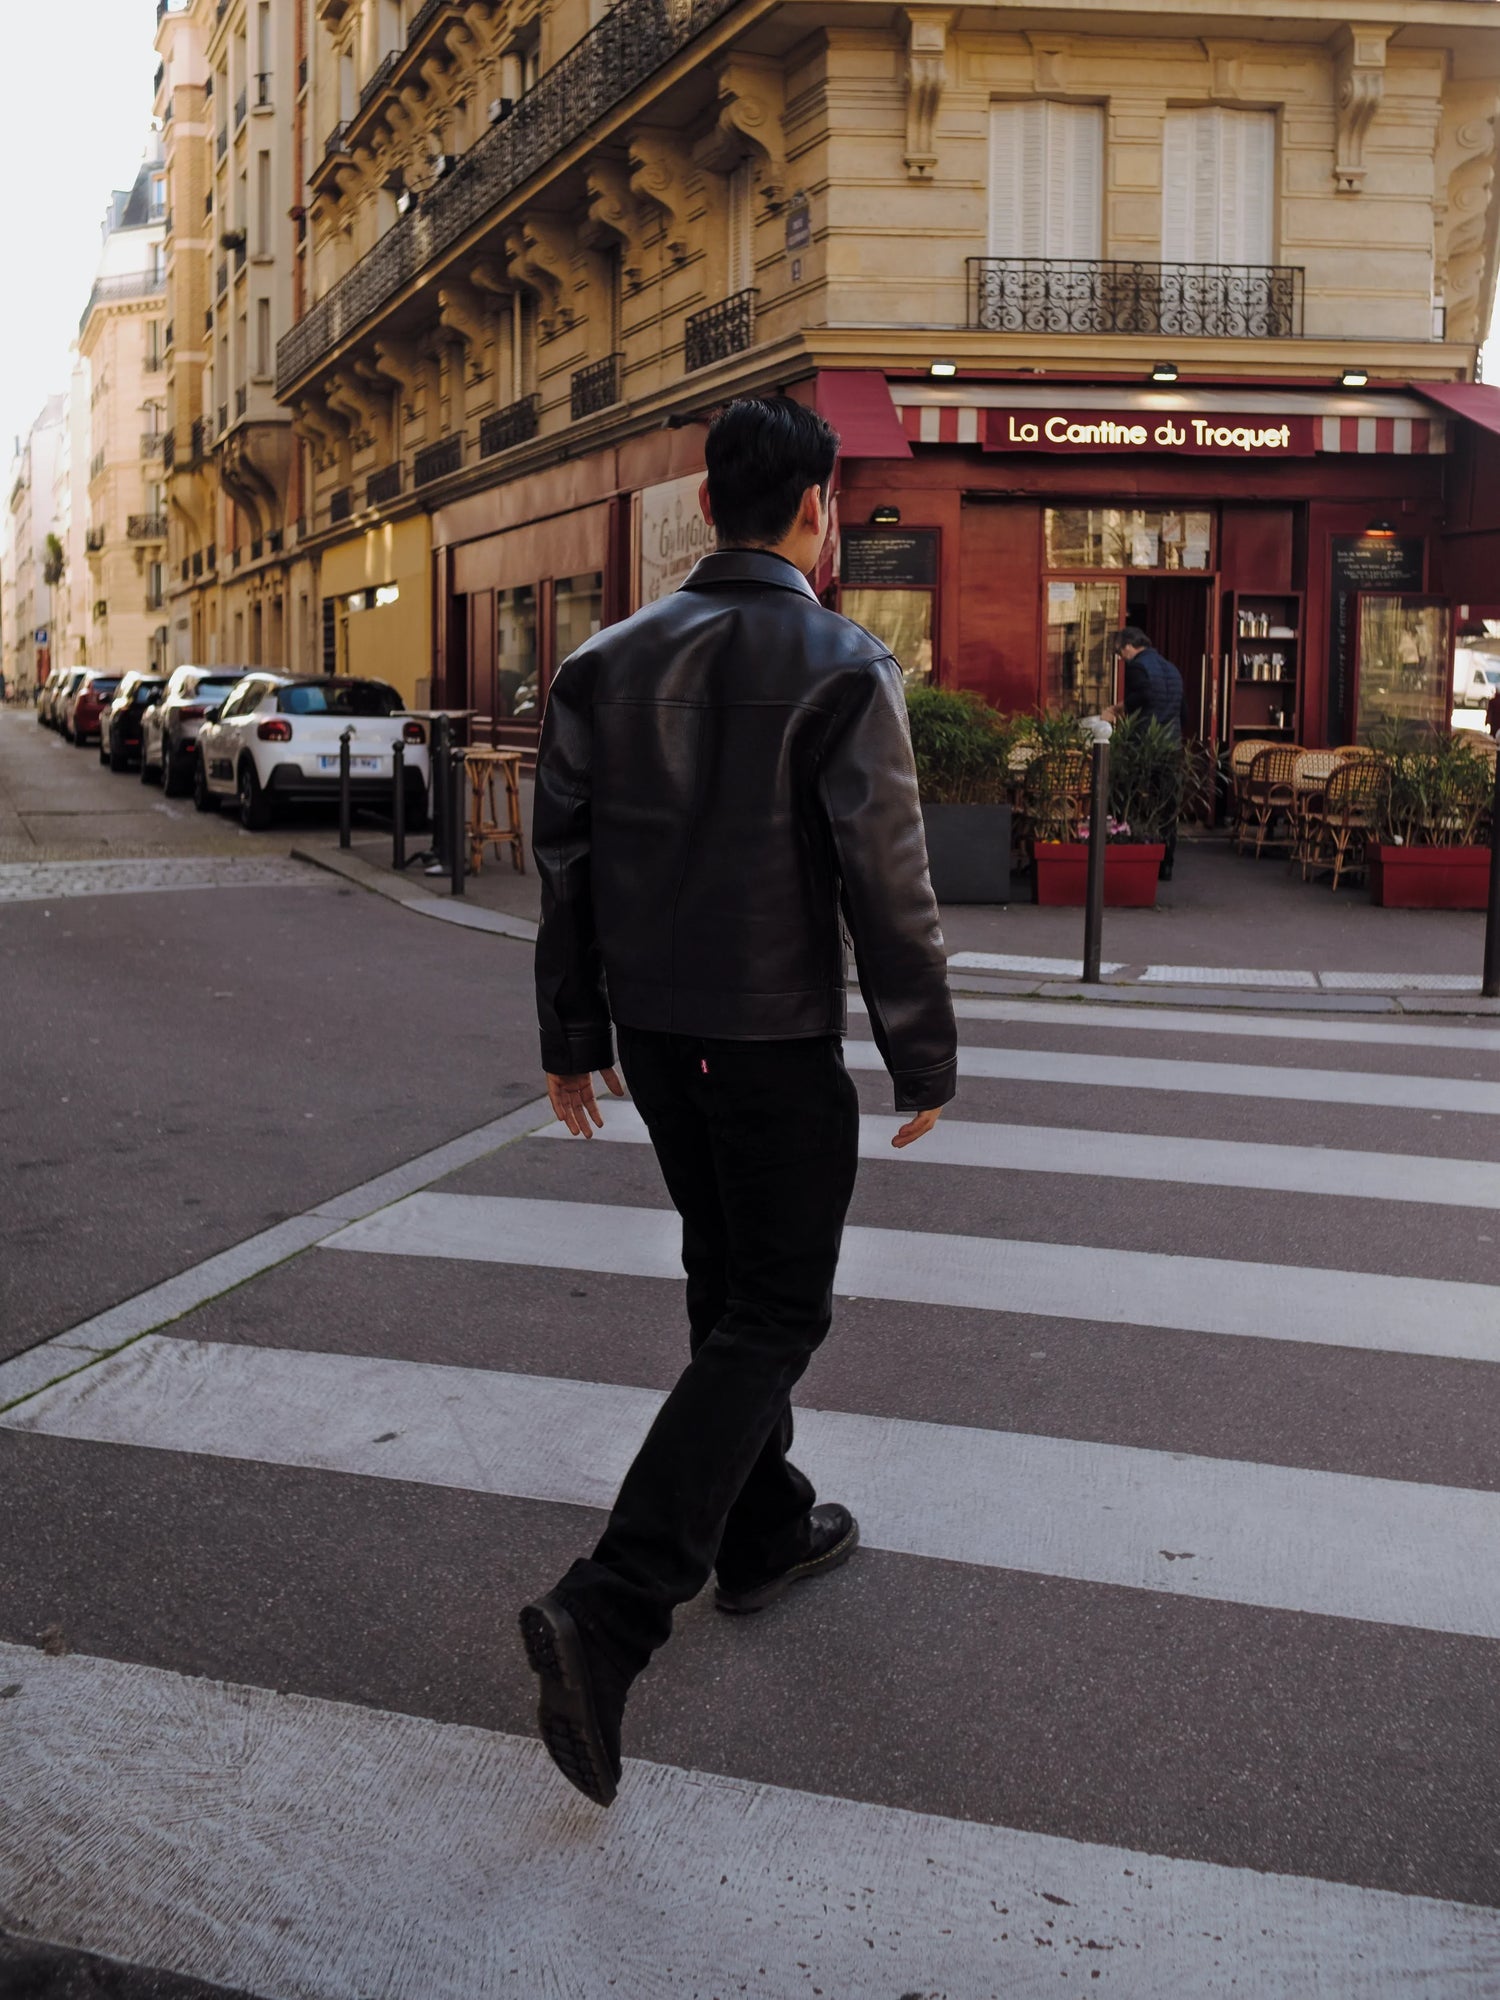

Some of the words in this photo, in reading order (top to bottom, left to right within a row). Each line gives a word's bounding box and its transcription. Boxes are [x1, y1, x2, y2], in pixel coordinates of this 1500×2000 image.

[1009, 416, 1038, 442] La
[1045, 416, 1147, 445] Cantine
[1154, 419, 1186, 446] du
[1191, 419, 1291, 452] Troquet
